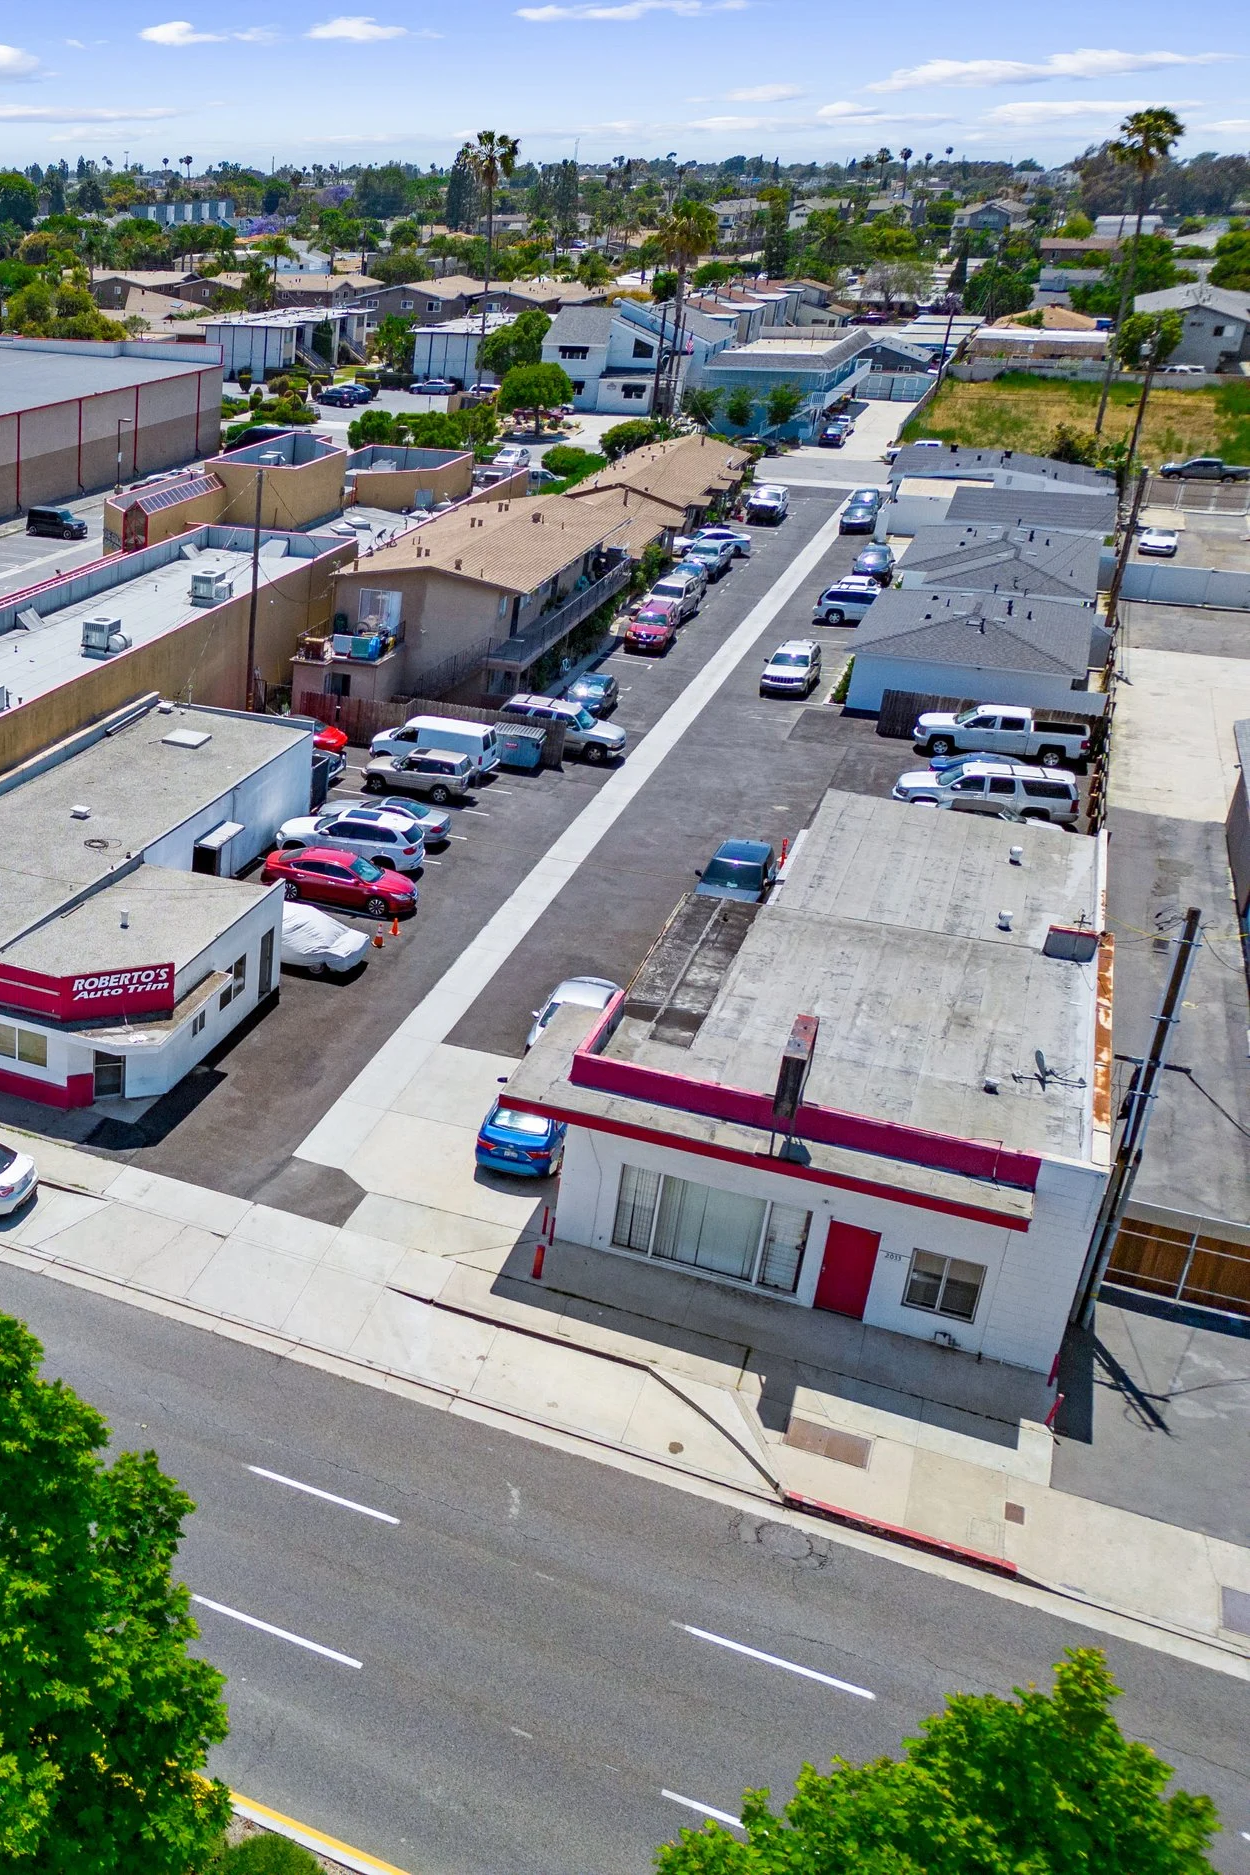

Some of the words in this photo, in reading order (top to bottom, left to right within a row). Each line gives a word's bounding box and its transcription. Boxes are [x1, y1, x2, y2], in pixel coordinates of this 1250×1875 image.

[72, 968, 169, 992] ROBERTO'S
[72, 988, 123, 1001] Auto
[127, 982, 170, 993] Trim
